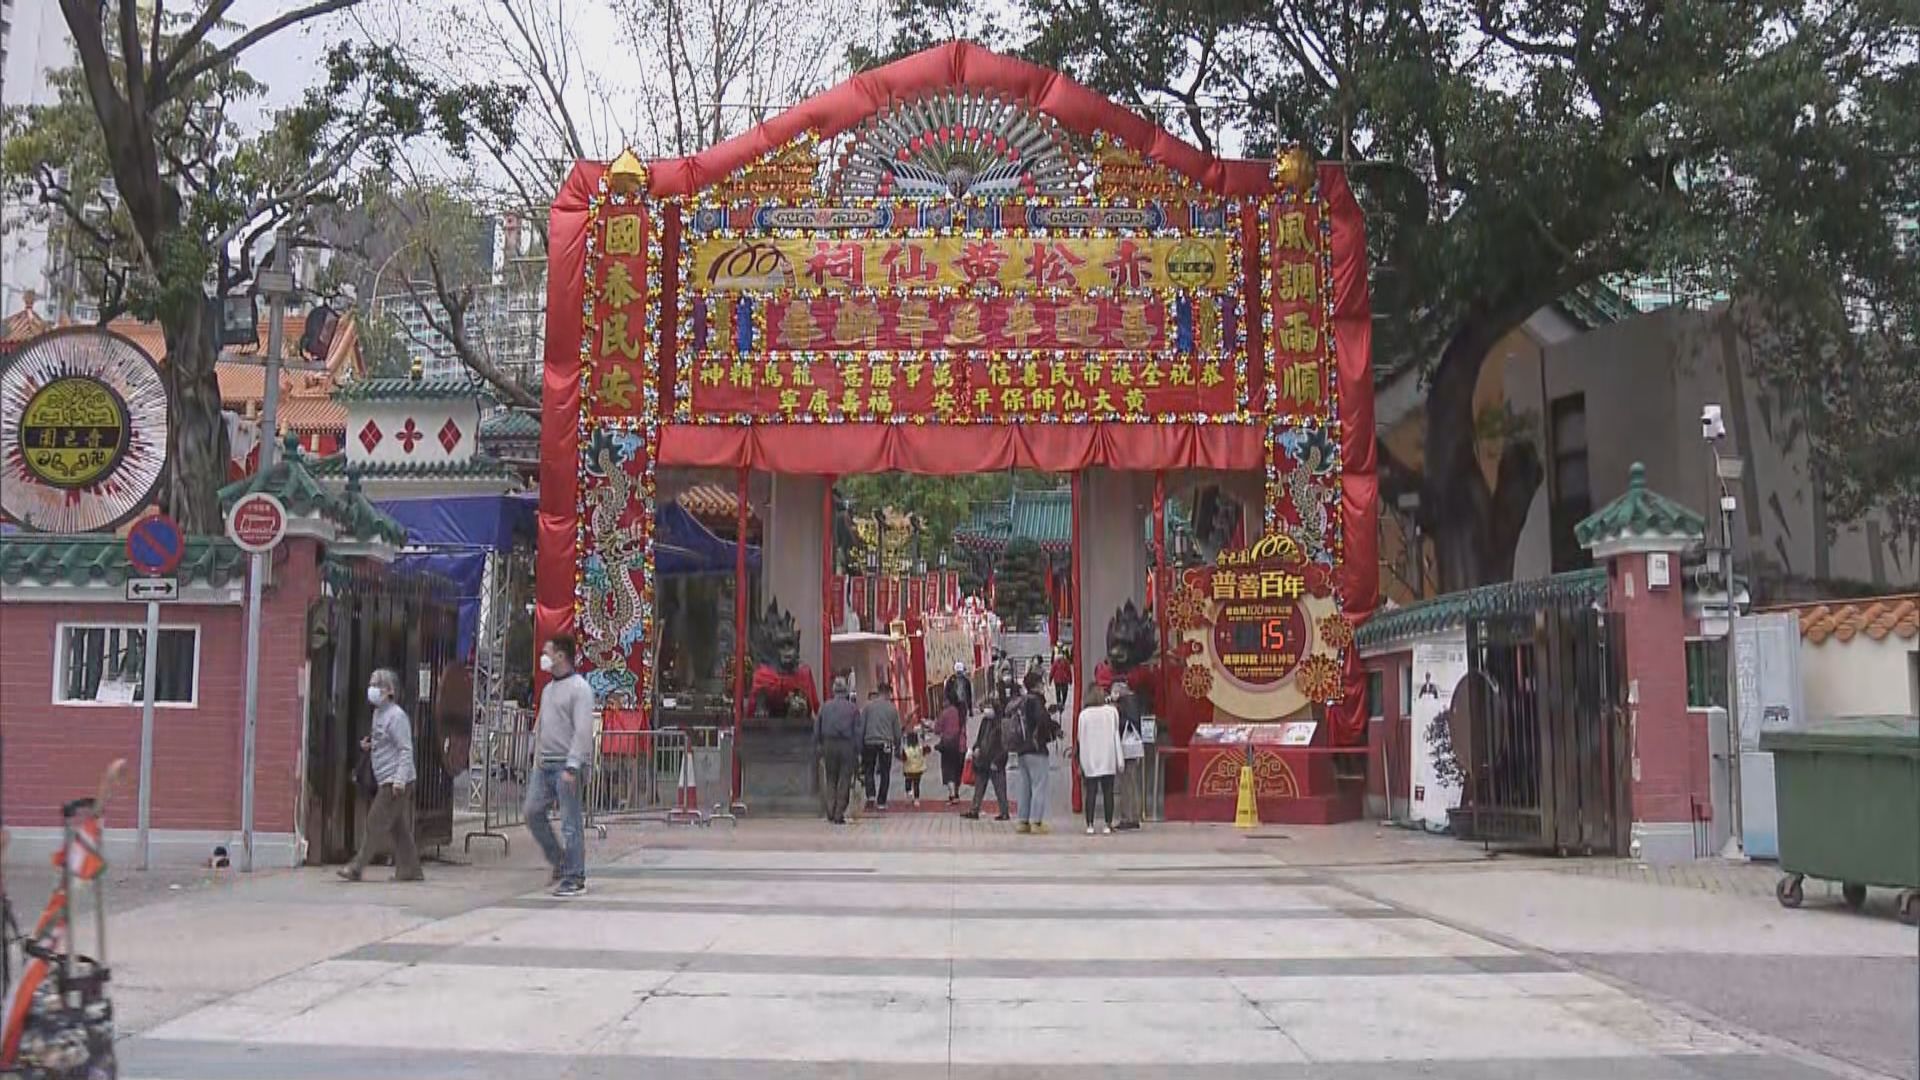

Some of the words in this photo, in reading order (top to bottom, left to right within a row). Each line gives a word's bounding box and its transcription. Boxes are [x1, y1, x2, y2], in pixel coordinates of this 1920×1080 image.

[598, 212, 642, 411] 國泰民安
[1276, 211, 1321, 408] 風調雨順
[1210, 570, 1305, 600] 普善百年
[1260, 619, 1284, 650] 15
